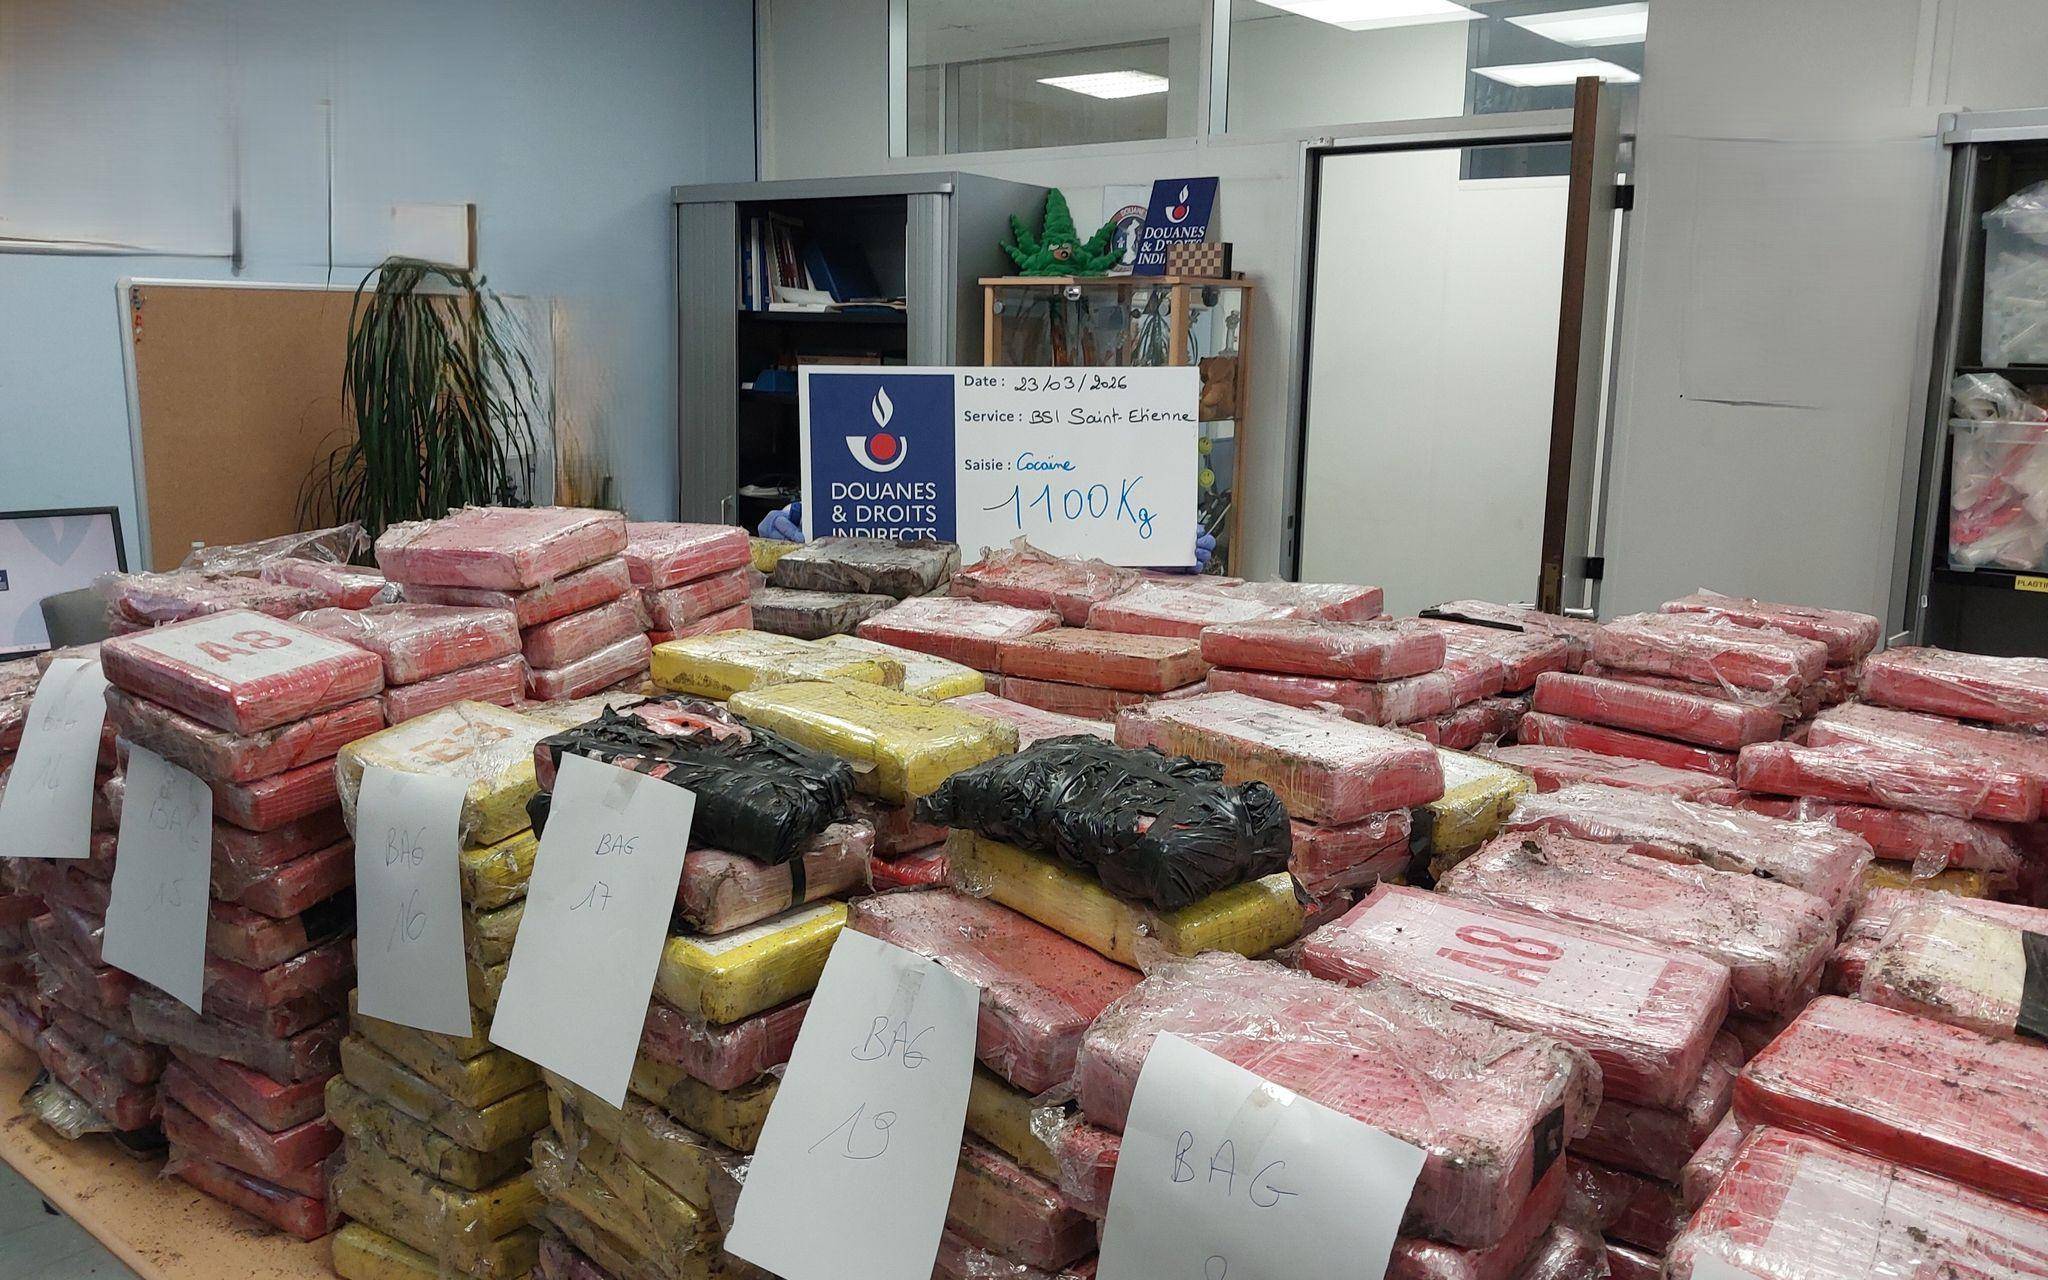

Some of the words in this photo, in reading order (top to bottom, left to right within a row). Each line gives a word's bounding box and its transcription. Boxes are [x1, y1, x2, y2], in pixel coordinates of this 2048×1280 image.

[1143, 226, 1206, 240] DOUANES
[964, 375, 998, 387] Date
[1014, 373, 1127, 393] 23/03/2026
[964, 410, 1015, 422] Service
[964, 458, 1004, 471] Saisie
[831, 482, 936, 500] DOUANES
[831, 505, 848, 523] &
[856, 505, 937, 523] DROITS
[195, 630, 293, 662] A8
[595, 833, 639, 856] BAG
[570, 881, 613, 912] 17
[387, 889, 427, 953] 16
[851, 1014, 937, 1070] BAG
[807, 1102, 899, 1160] 19
[1170, 1130, 1300, 1208] BAG
